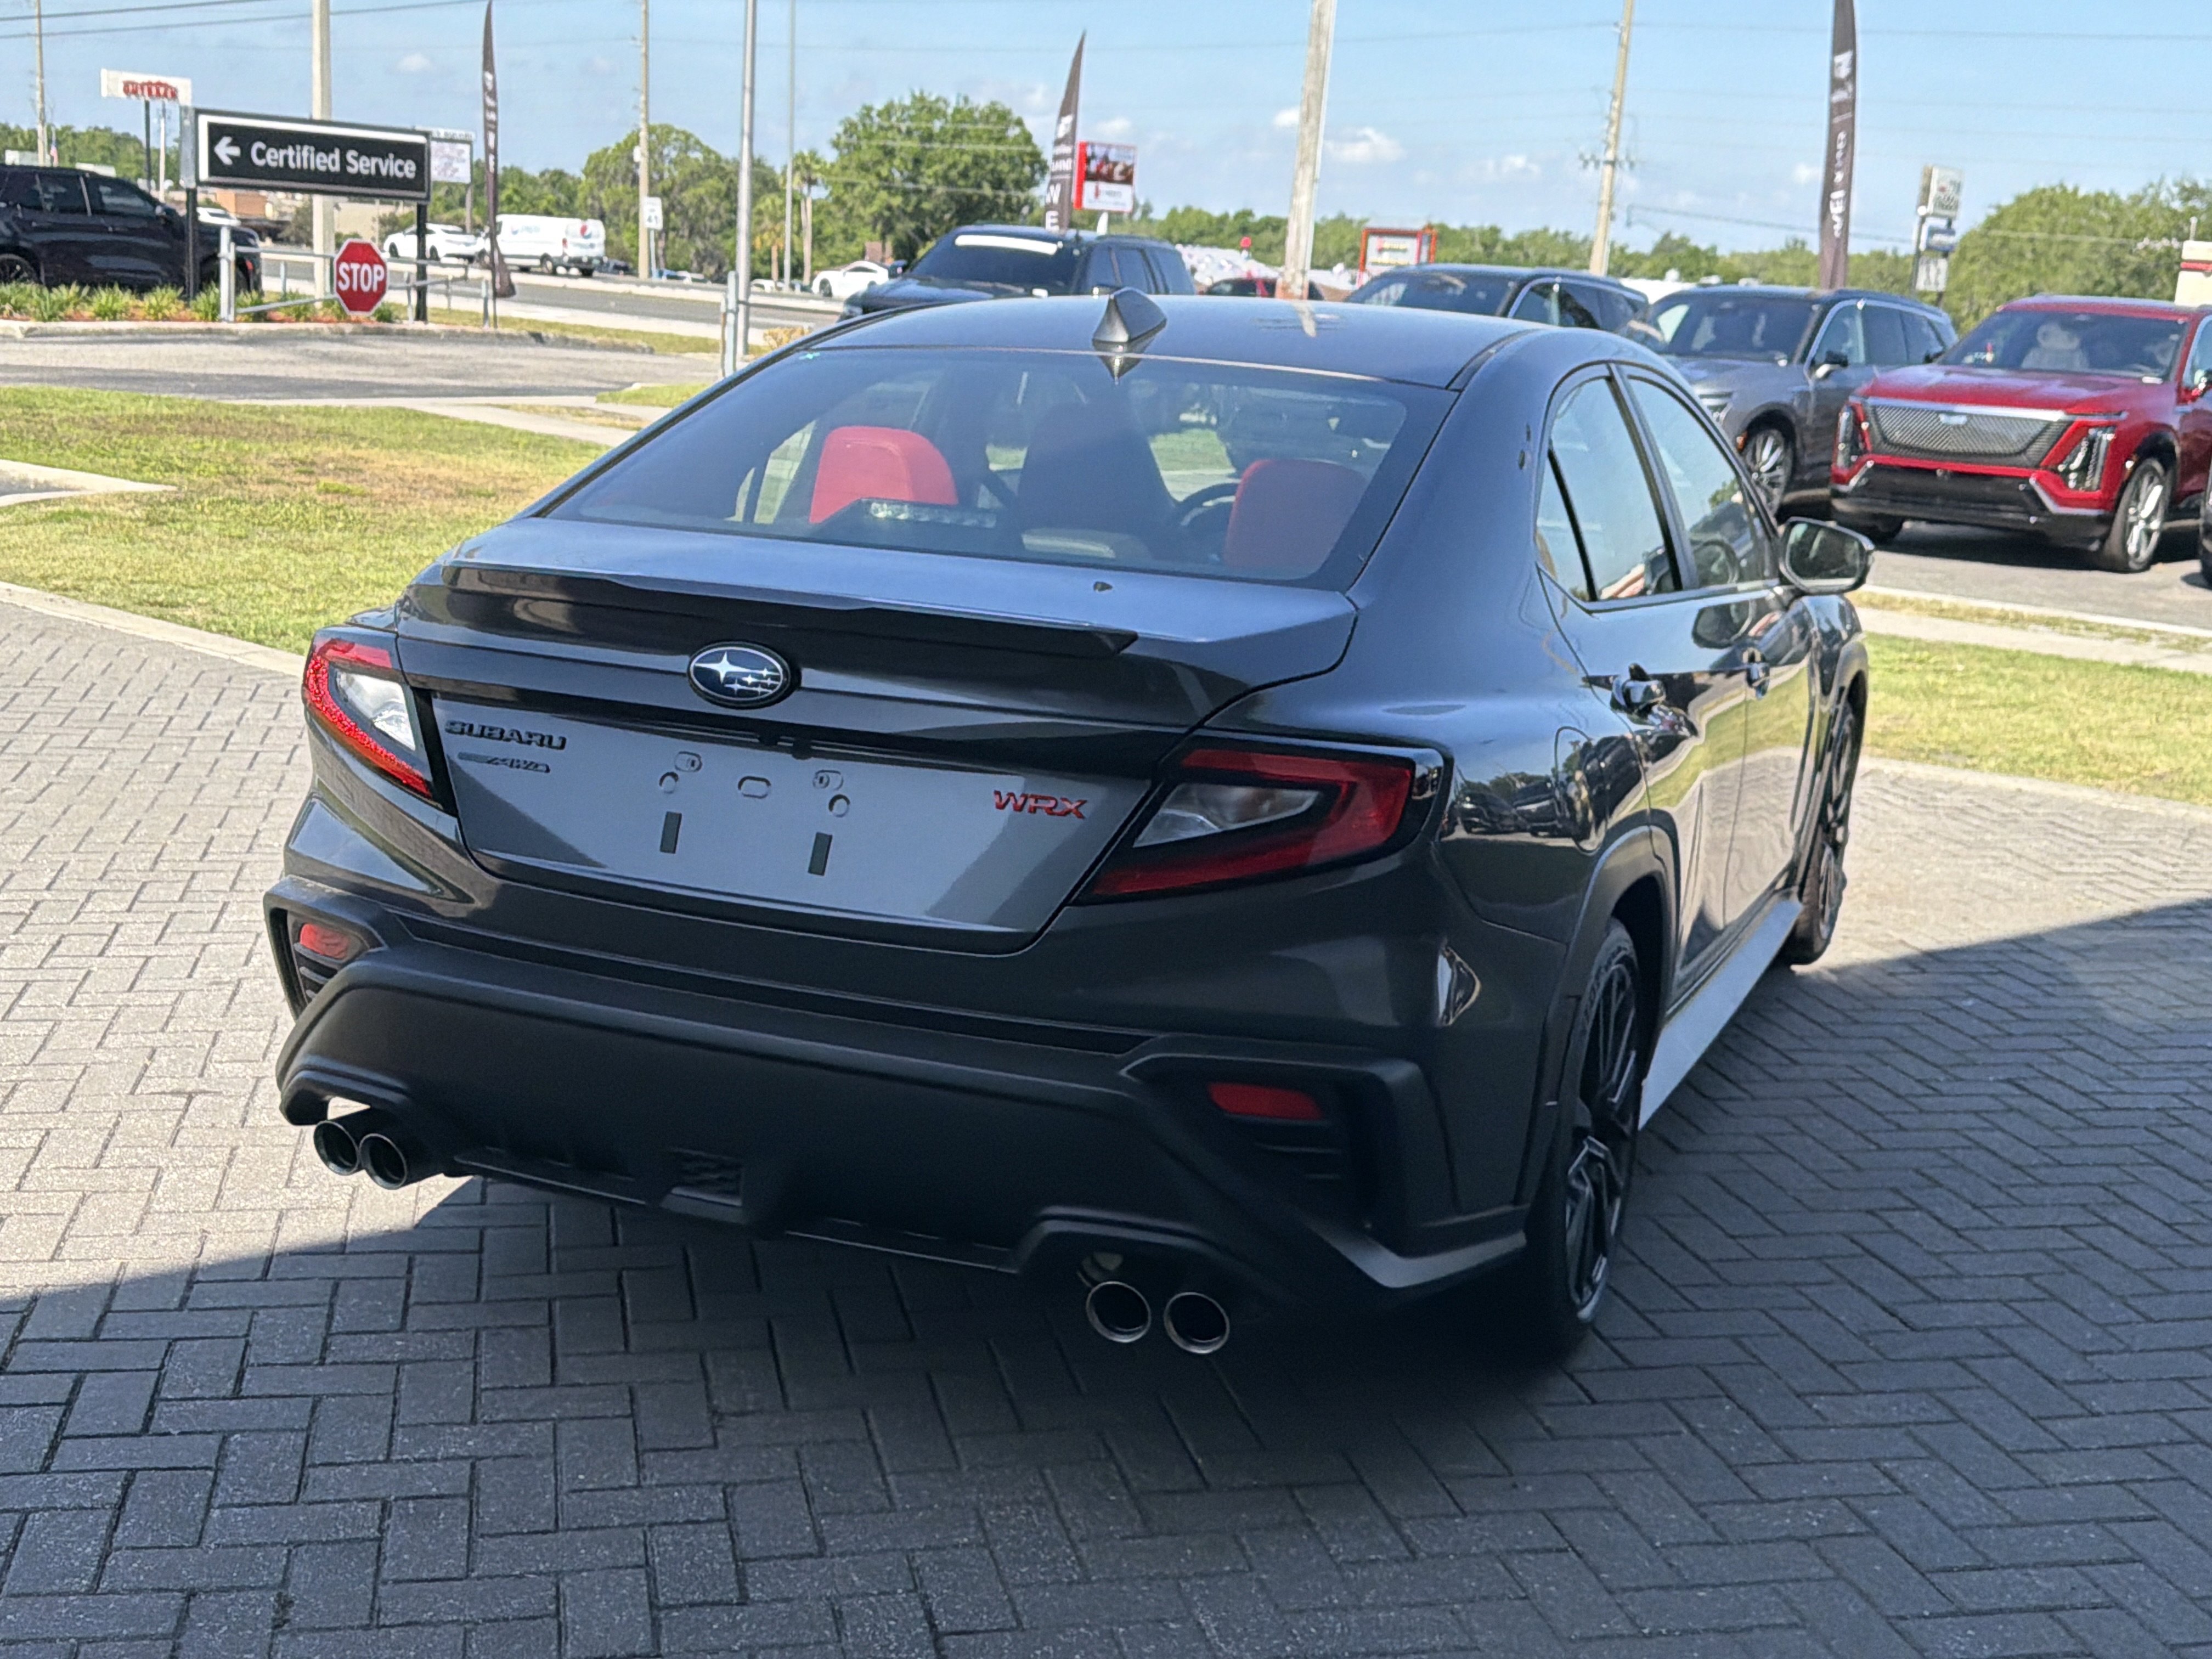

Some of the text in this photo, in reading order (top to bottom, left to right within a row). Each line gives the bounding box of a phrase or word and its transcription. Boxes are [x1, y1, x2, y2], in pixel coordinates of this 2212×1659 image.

[251, 140, 341, 173] Certified
[346, 149, 416, 179] Service
[338, 261, 385, 292] STOP
[444, 719, 567, 751] SUBARU
[994, 789, 1087, 819] WRX
